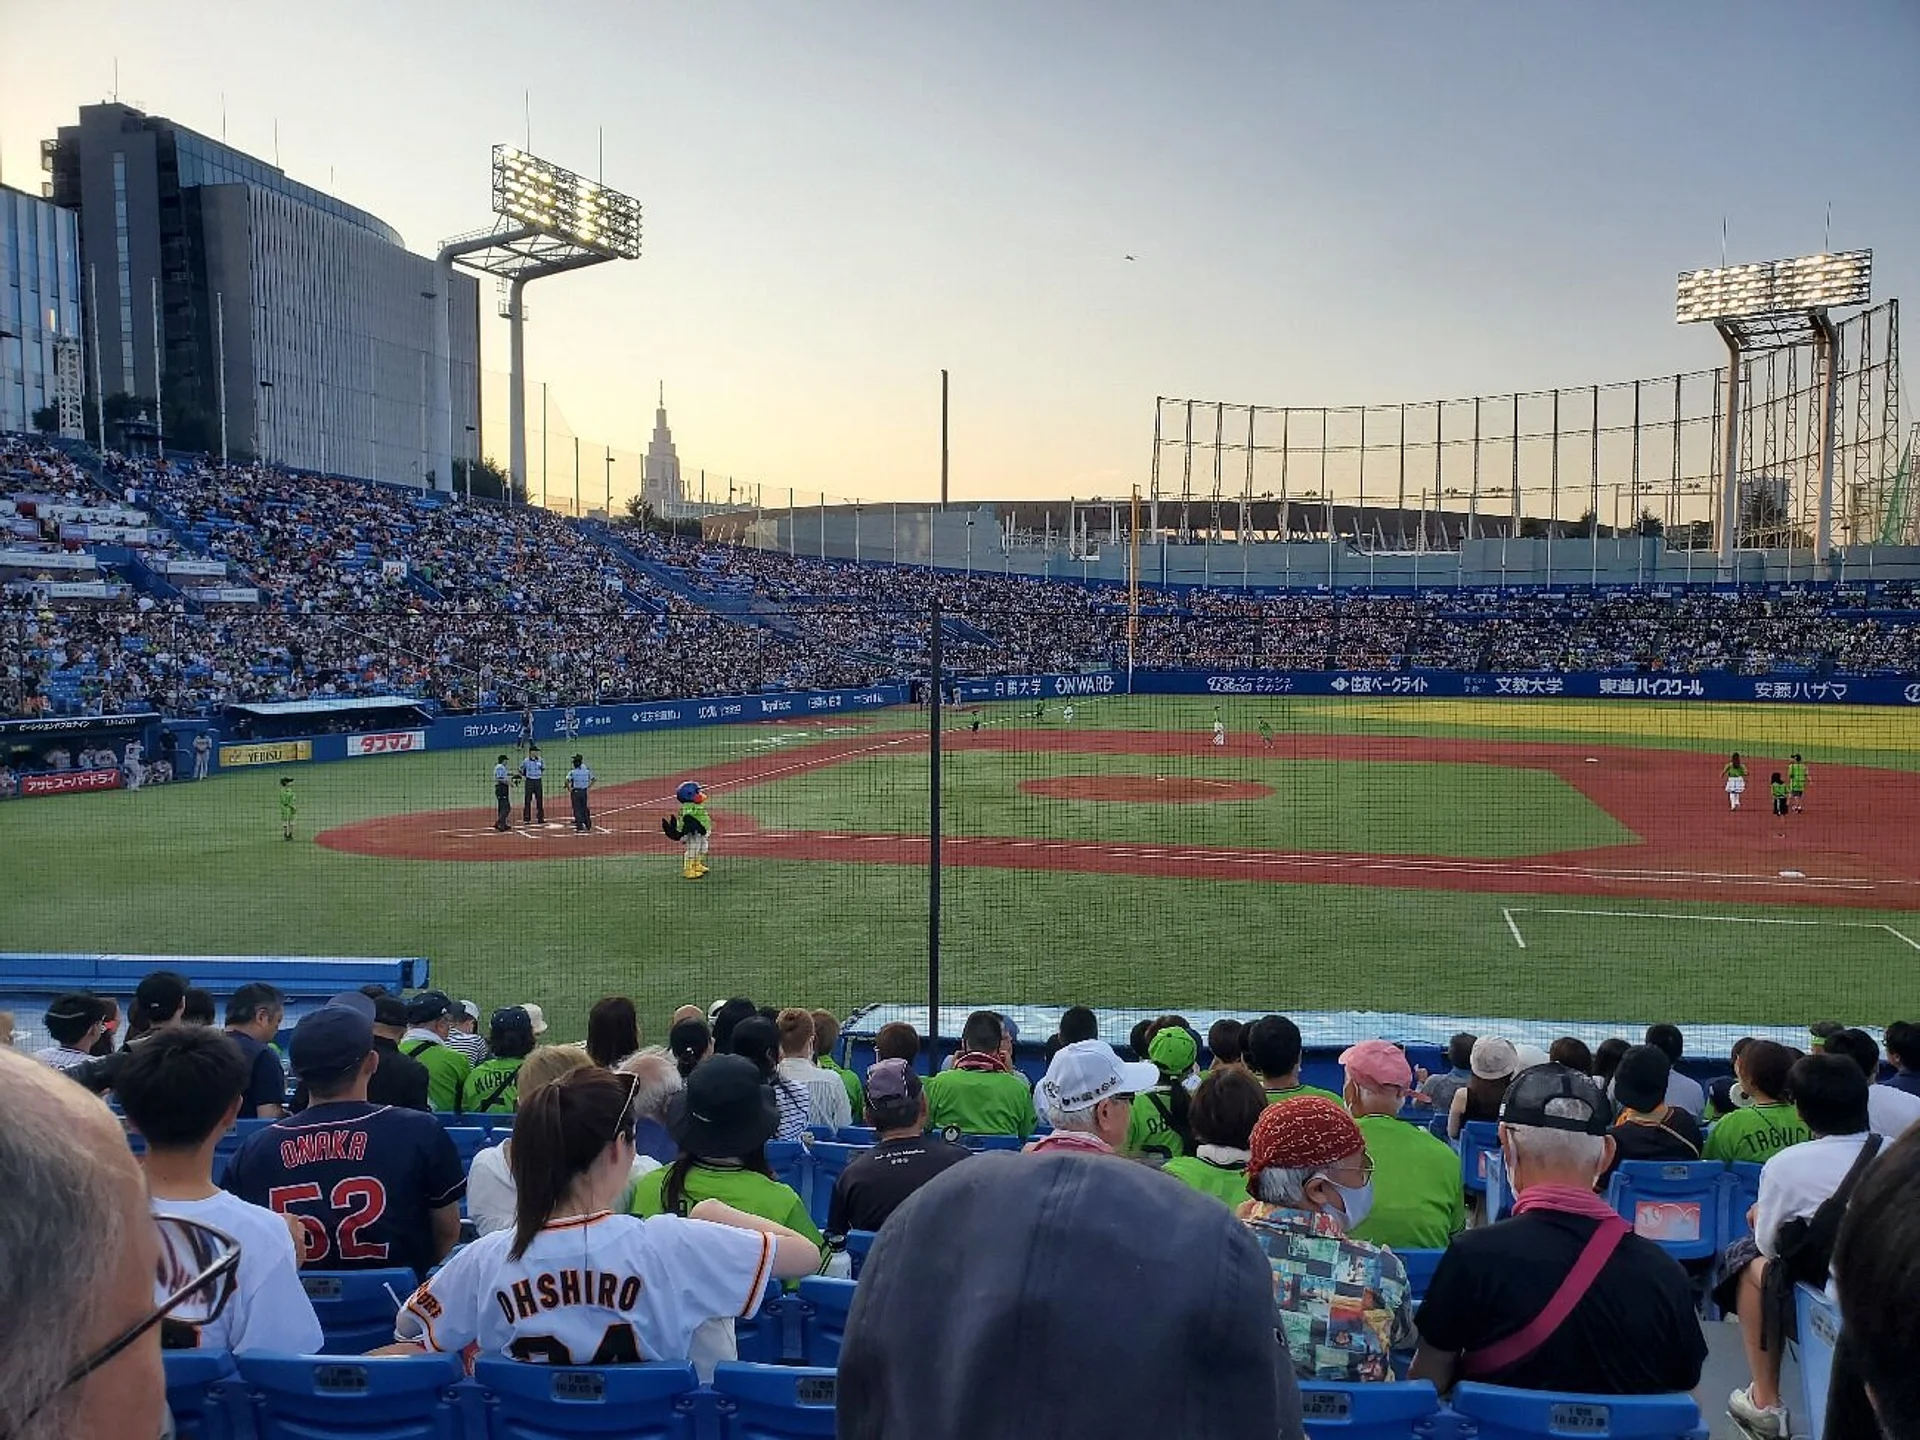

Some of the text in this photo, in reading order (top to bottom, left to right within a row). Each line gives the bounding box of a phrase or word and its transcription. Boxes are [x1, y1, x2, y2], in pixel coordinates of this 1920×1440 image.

[1055, 675, 1114, 695] ONWARD
[1351, 676, 1428, 693] 住友ベークライト
[1495, 676, 1563, 694] 文教大学
[1599, 679, 1705, 696] 東進ハイスクール
[1754, 682, 1848, 700] 安藤ハザマ
[360, 733, 414, 752] タフマン
[247, 750, 282, 763] YEBISU
[280, 1130, 370, 1170] ONAKA
[268, 1176, 393, 1266] 52
[495, 1269, 642, 1324] OHSHIRO
